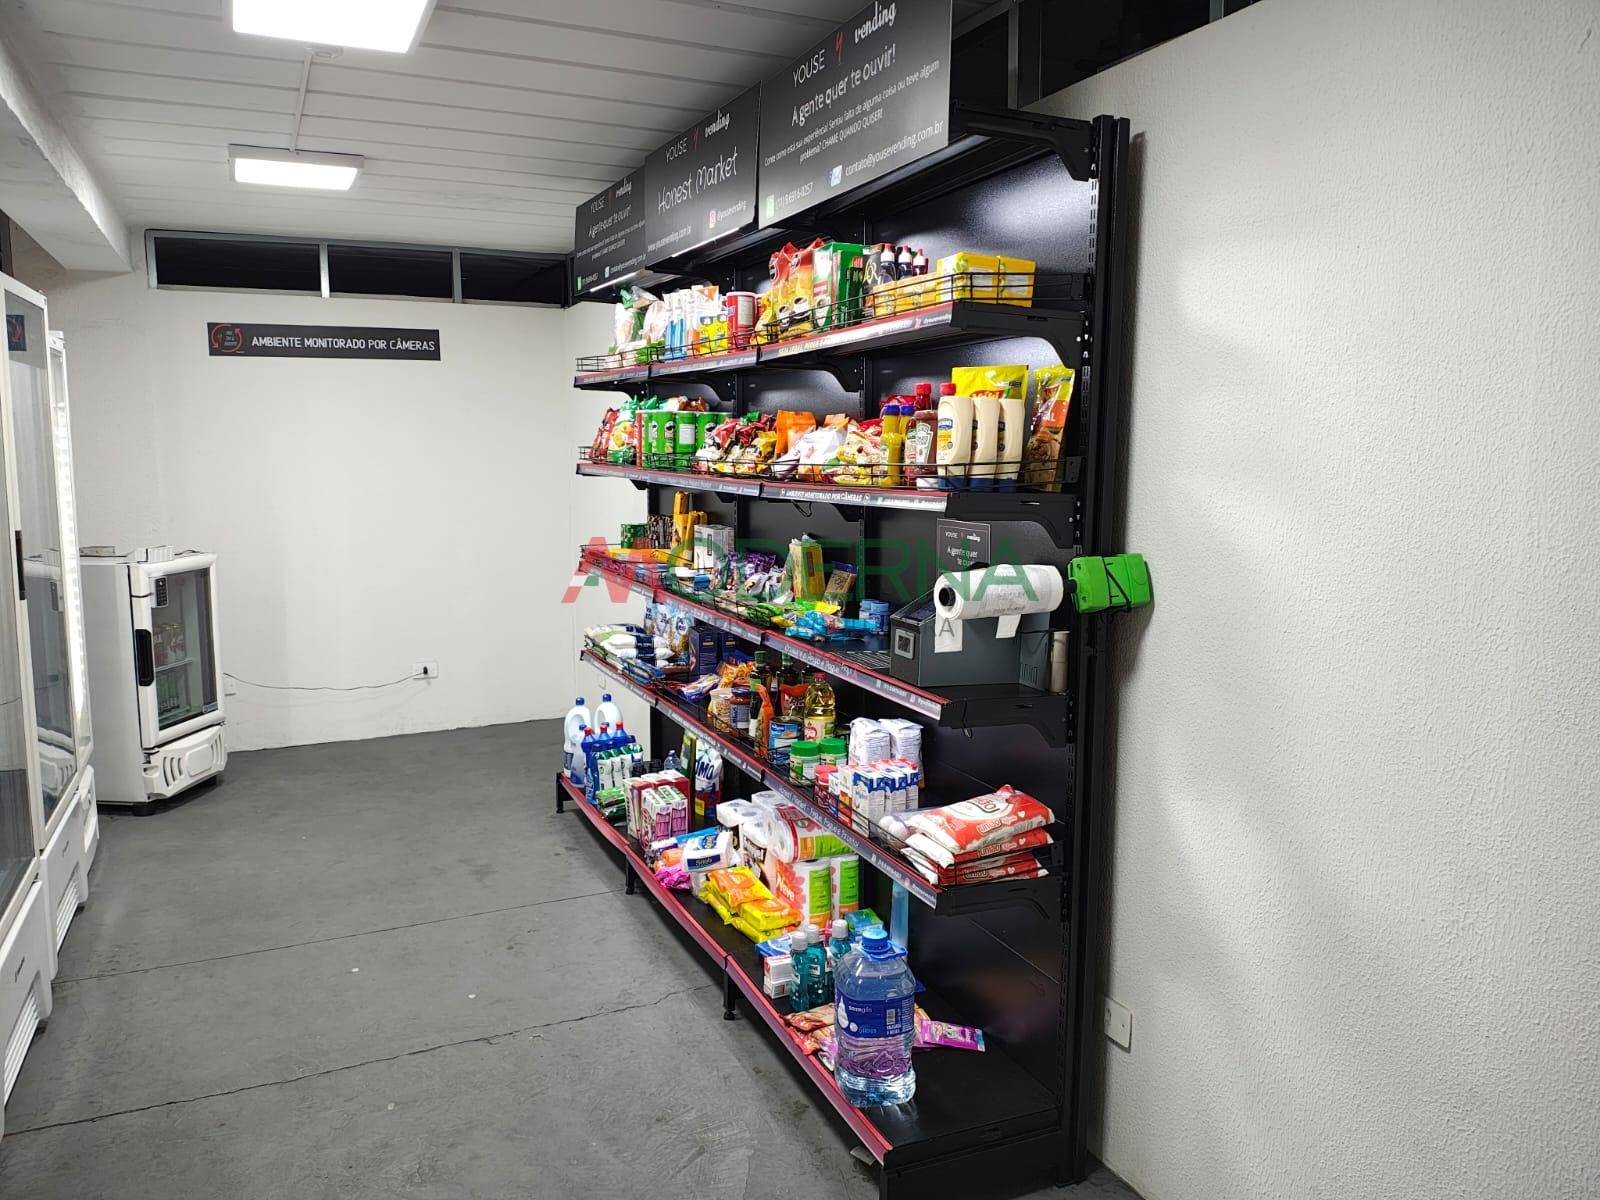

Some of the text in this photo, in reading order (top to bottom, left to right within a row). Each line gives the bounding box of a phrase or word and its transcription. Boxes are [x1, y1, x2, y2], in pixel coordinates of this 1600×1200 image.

[854, 0, 897, 44] vending
[791, 43, 896, 127] A gente quer te ouvir!
[792, 49, 826, 88] YOUSE
[665, 137, 688, 164] YOUSE
[658, 145, 738, 215] Honest Market
[251, 335, 302, 348] AMBIENTE
[304, 337, 365, 350] MONITORADO
[368, 339, 387, 350] POR
[389, 337, 436, 351] CÂMERAS
[776, 872, 795, 902] Neve
